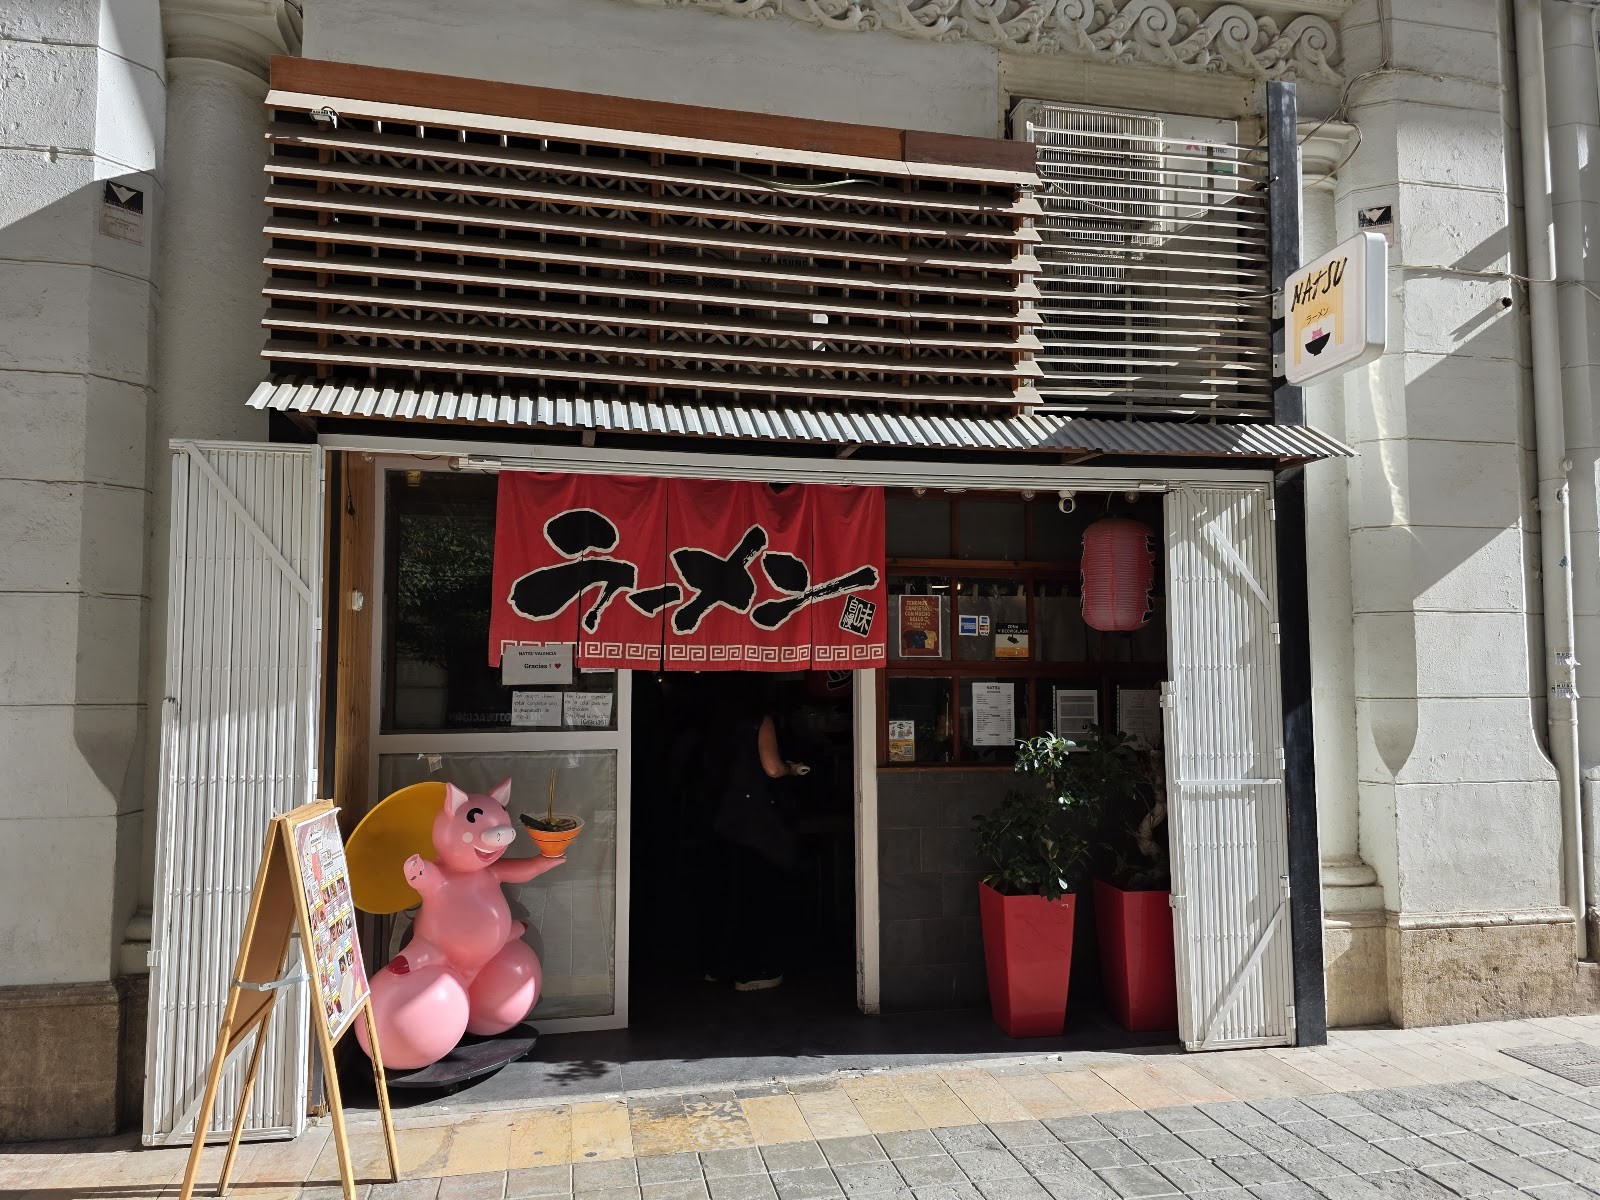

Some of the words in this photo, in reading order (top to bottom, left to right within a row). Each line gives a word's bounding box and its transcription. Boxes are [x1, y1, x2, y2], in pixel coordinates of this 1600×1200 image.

[1201, 145, 1227, 154] ELCTRIC
[1290, 257, 1348, 313] NATSU
[507, 507, 880, 636] ラーメン
